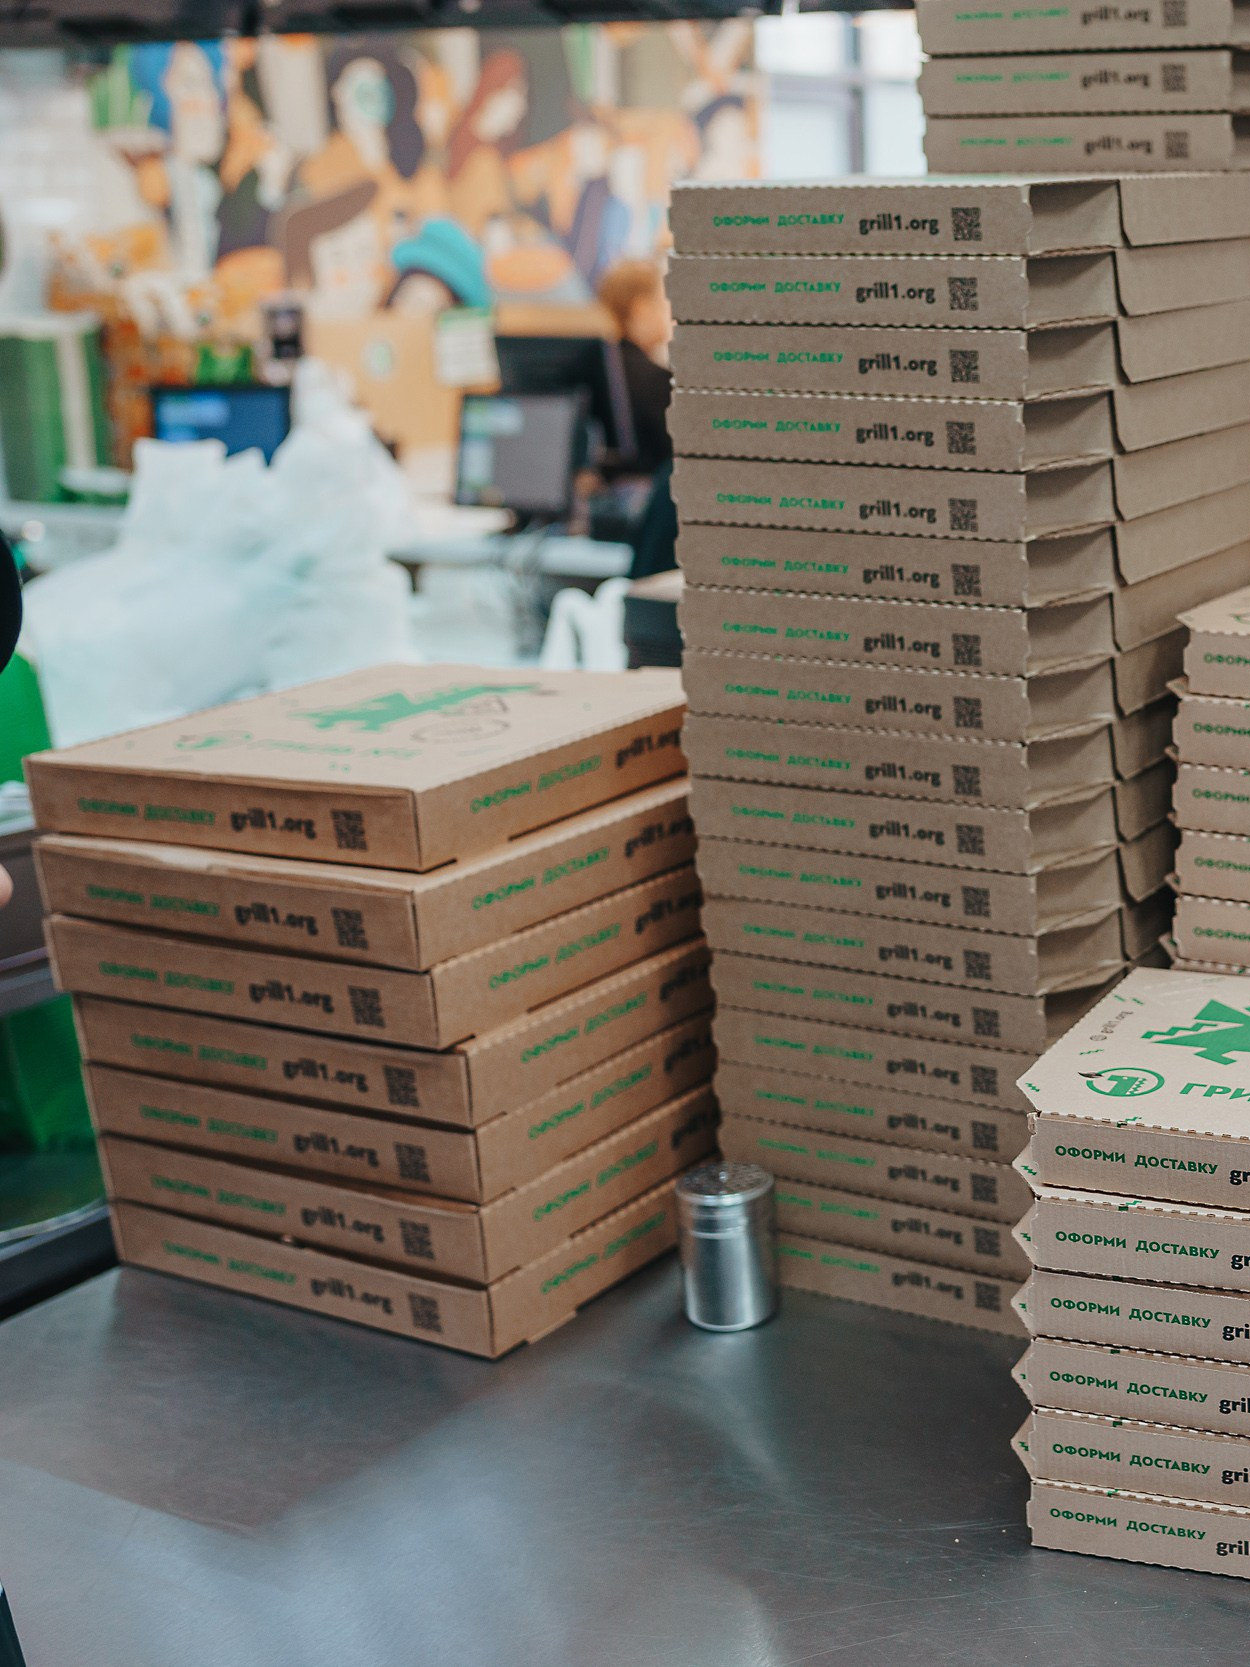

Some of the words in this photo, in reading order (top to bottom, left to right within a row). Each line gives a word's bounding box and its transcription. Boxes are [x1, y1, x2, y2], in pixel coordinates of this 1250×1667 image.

[711, 213, 771, 229] ОФОРМИ
[774, 211, 846, 229] ДОСТАВКУ
[858, 212, 940, 236] grill1.org
[707, 280, 768, 295] ОФОРМИ
[771, 279, 842, 295] ДОСТАВКУ
[855, 281, 936, 305] grill1.org
[712, 350, 771, 364] ОФОРМИ
[774, 350, 845, 369] ДОСТАВКУ
[858, 352, 938, 377] grill1.org
[711, 415, 769, 432] ОФОРМИ
[773, 419, 842, 434] ДОСТАВКУ
[855, 422, 935, 448] grill1.org
[714, 491, 774, 507] ОФОРМИ
[777, 495, 846, 512] ДОСТАВКУ
[858, 499, 937, 525] grill1.org
[719, 554, 779, 570] ОФОРМИ
[782, 559, 850, 576] ДОСТАВКУ
[862, 564, 941, 590] grill1.org
[721, 619, 779, 636] ОФОРМИ
[783, 625, 852, 643] ДОСТАВКУ
[863, 632, 941, 659] grill1.org
[722, 682, 781, 699] ОФОРМИ
[785, 688, 853, 705] ДОСТАВКУ
[864, 695, 943, 722] grill1.org
[864, 762, 942, 788] grill1.org
[1191, 788, 1250, 804] ОФОРМИ
[868, 820, 946, 847] grill1.org
[874, 882, 952, 909] grill1.org
[877, 944, 954, 971] grill1.org
[1055, 1145, 1127, 1165] ОФОРМИ
[1133, 1154, 1219, 1176] ДОСТАВКУ
[1055, 1231, 1128, 1250] ОФОРМИ
[1135, 1239, 1221, 1261] ДОСТАВКУ
[1049, 1297, 1121, 1318] ОФОРМИ
[1127, 1307, 1212, 1330] ДОСТАВКУ
[1048, 1370, 1119, 1392] ОФОРМИ
[1126, 1381, 1209, 1404] ДОСТАВКУ
[1051, 1442, 1122, 1464] ОФОРМИ
[1128, 1454, 1212, 1477] ДОСТАВКУ
[1049, 1507, 1118, 1529] ОФОРМИ
[1124, 1519, 1207, 1542] ДОСТАВКУ
